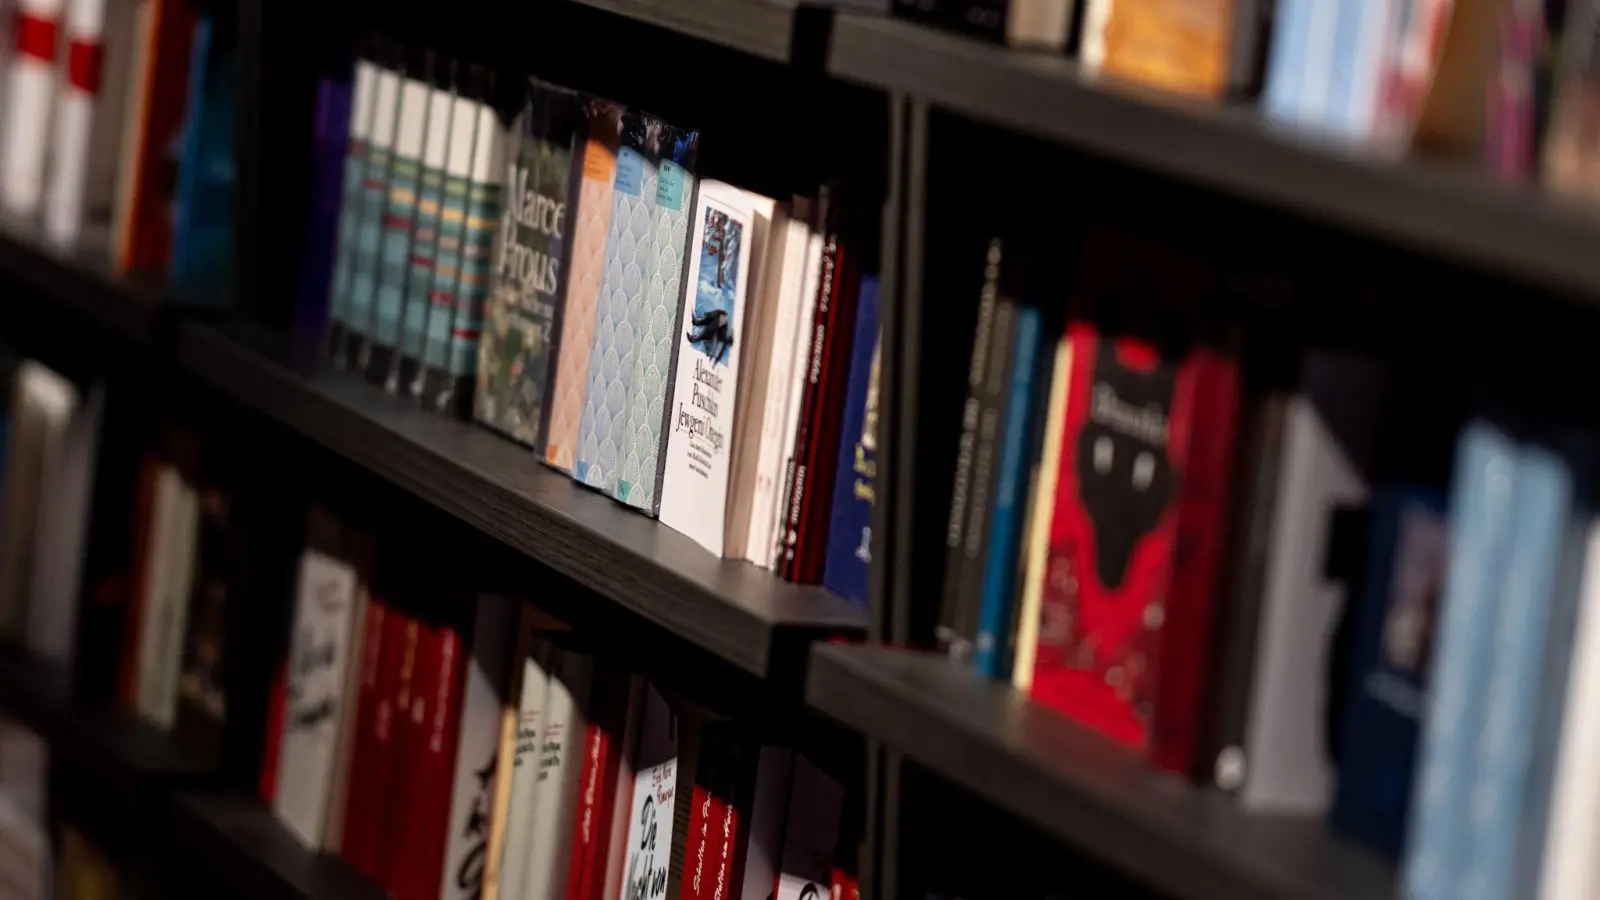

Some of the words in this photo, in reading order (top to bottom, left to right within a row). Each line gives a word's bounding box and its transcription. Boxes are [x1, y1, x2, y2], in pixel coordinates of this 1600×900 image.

[693, 358, 723, 394] Alexander
[691, 382, 720, 418] Puschkin
[676, 402, 705, 439] Jewgeni
[640, 794, 658, 852] Die
[693, 840, 706, 896] Schatten
[701, 822, 708, 836] im
[714, 862, 726, 900] Station
[722, 841, 729, 859] am
[650, 866, 667, 899] von
